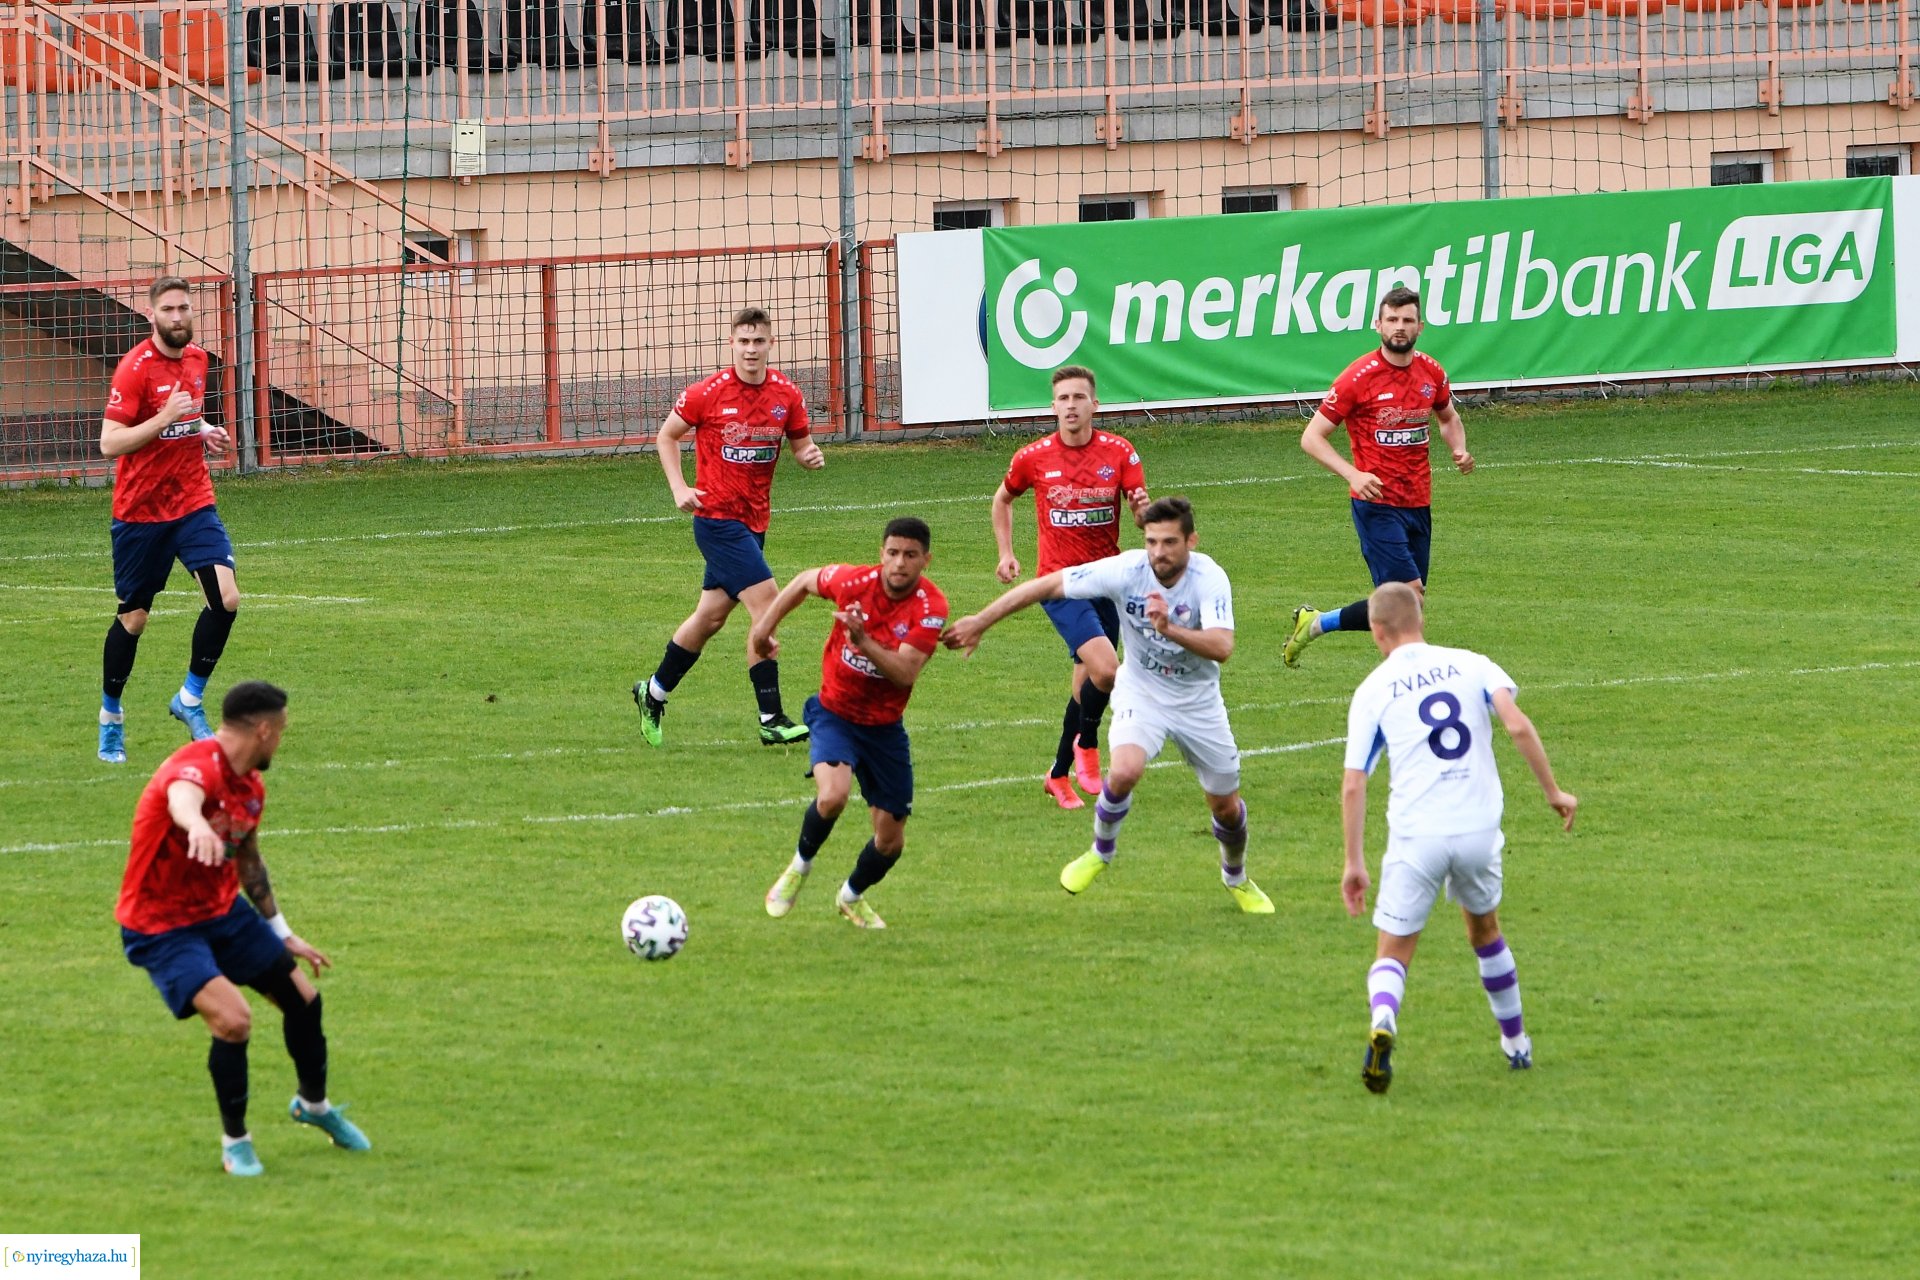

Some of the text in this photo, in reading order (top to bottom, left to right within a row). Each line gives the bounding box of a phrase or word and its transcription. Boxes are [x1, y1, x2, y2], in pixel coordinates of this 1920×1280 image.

[1108, 221, 1864, 346] merkantilbank LIGA
[1126, 601, 1146, 618] 81
[1387, 664, 1462, 699] ZVARA
[1418, 691, 1472, 761] 8
